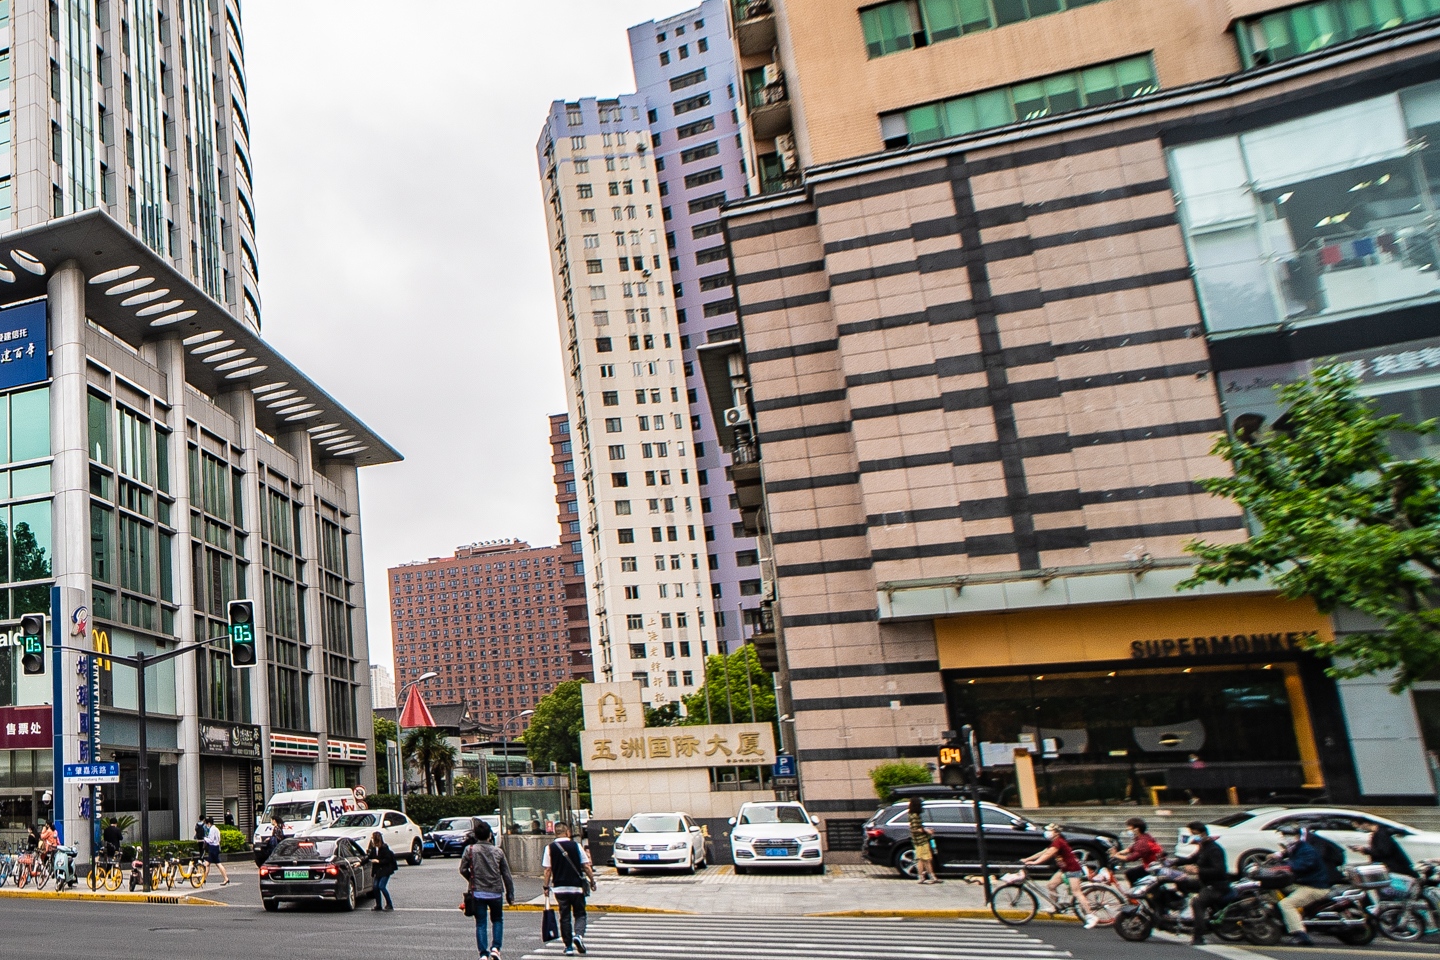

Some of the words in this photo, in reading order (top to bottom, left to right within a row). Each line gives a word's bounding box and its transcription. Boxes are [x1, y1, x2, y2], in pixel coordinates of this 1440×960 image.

[233, 625, 251, 644] 05
[25, 637, 43, 654] 05
[6, 722, 42, 736] 售票处
[591, 731, 765, 761] 五洲国际大厦
[779, 757, 789, 766] P
[940, 748, 962, 764] 04
[75, 765, 107, 775] 肇嘉浜路
